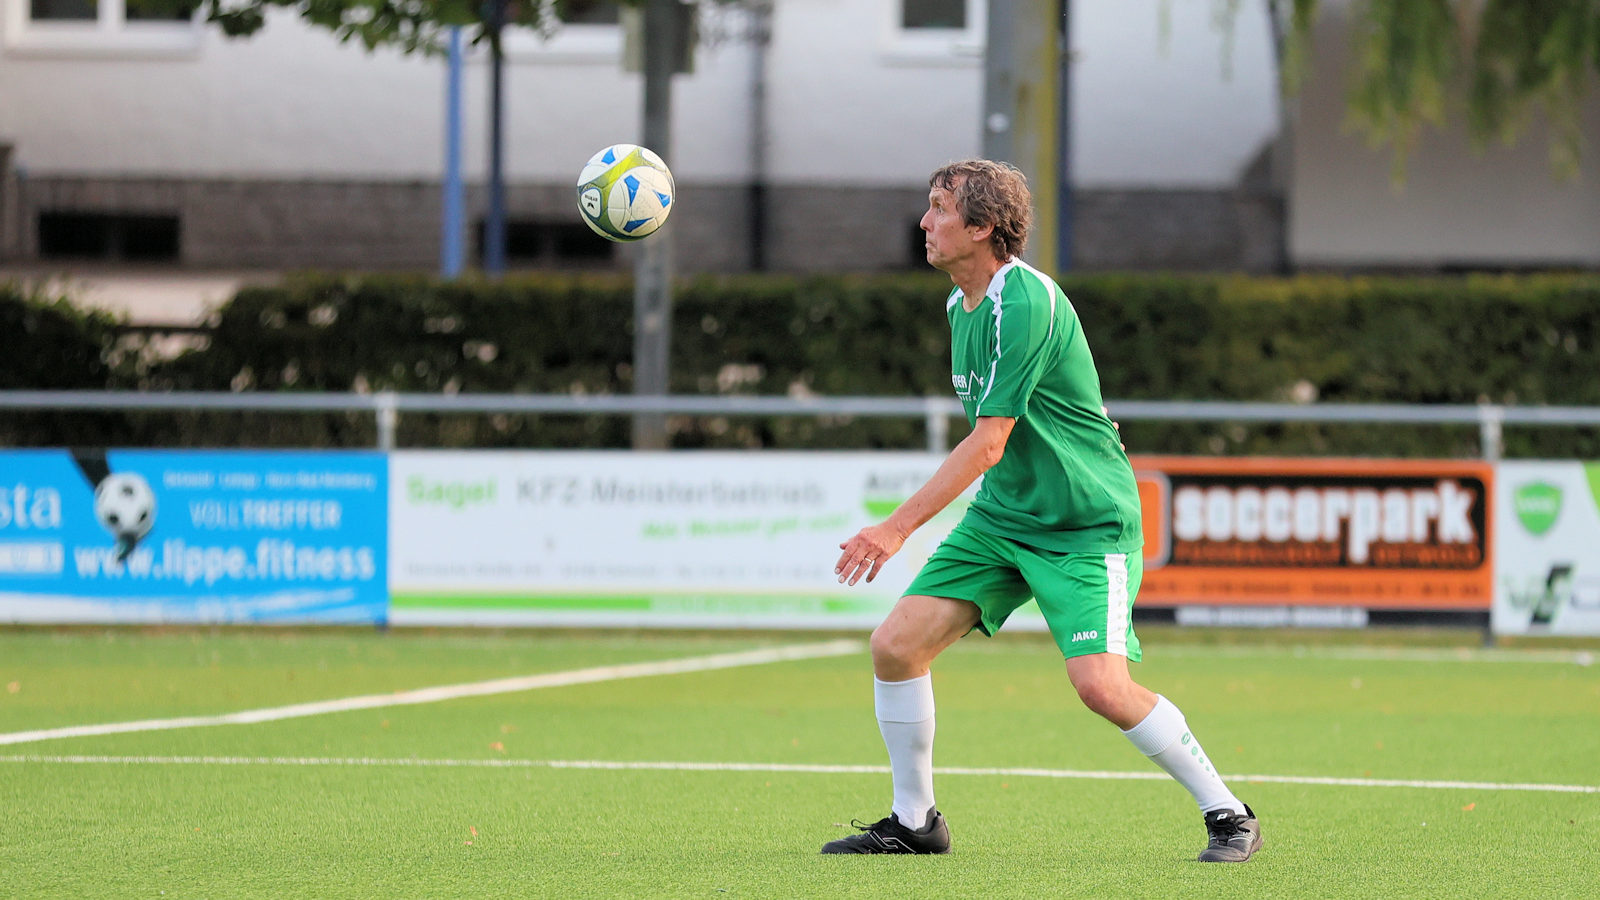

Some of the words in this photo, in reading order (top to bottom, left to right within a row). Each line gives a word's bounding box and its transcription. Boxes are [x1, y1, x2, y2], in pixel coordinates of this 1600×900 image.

[1174, 480, 1476, 564] soccerpark
[75, 538, 375, 586] www.lippe.fitness
[1071, 630, 1098, 642] JAKO
